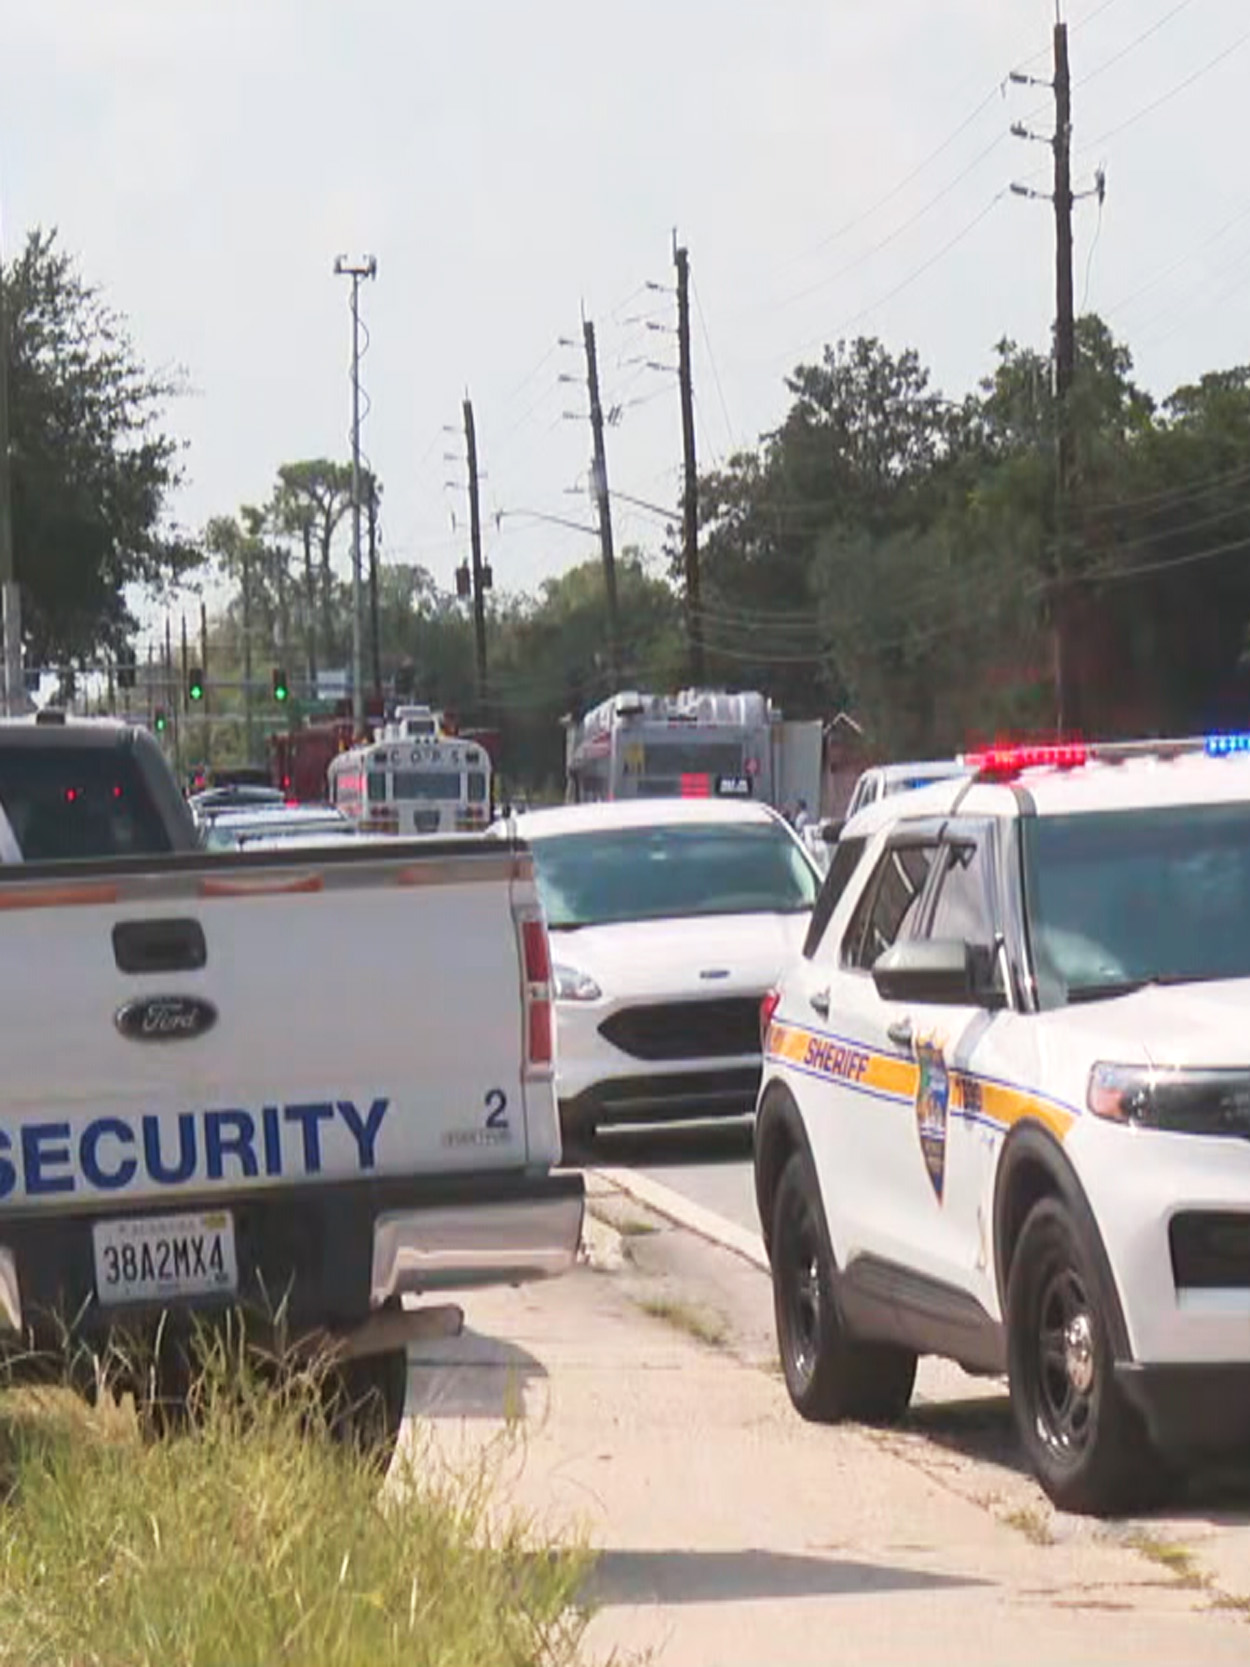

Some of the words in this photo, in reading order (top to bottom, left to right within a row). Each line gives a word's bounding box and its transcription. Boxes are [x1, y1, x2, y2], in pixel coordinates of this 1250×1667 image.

[142, 1003, 199, 1031] Ford
[804, 1037, 870, 1082] SHERIFF
[485, 1088, 508, 1128] 2
[0, 1098, 389, 1200] SECURITY
[104, 1234, 223, 1284] 38A2MX4
